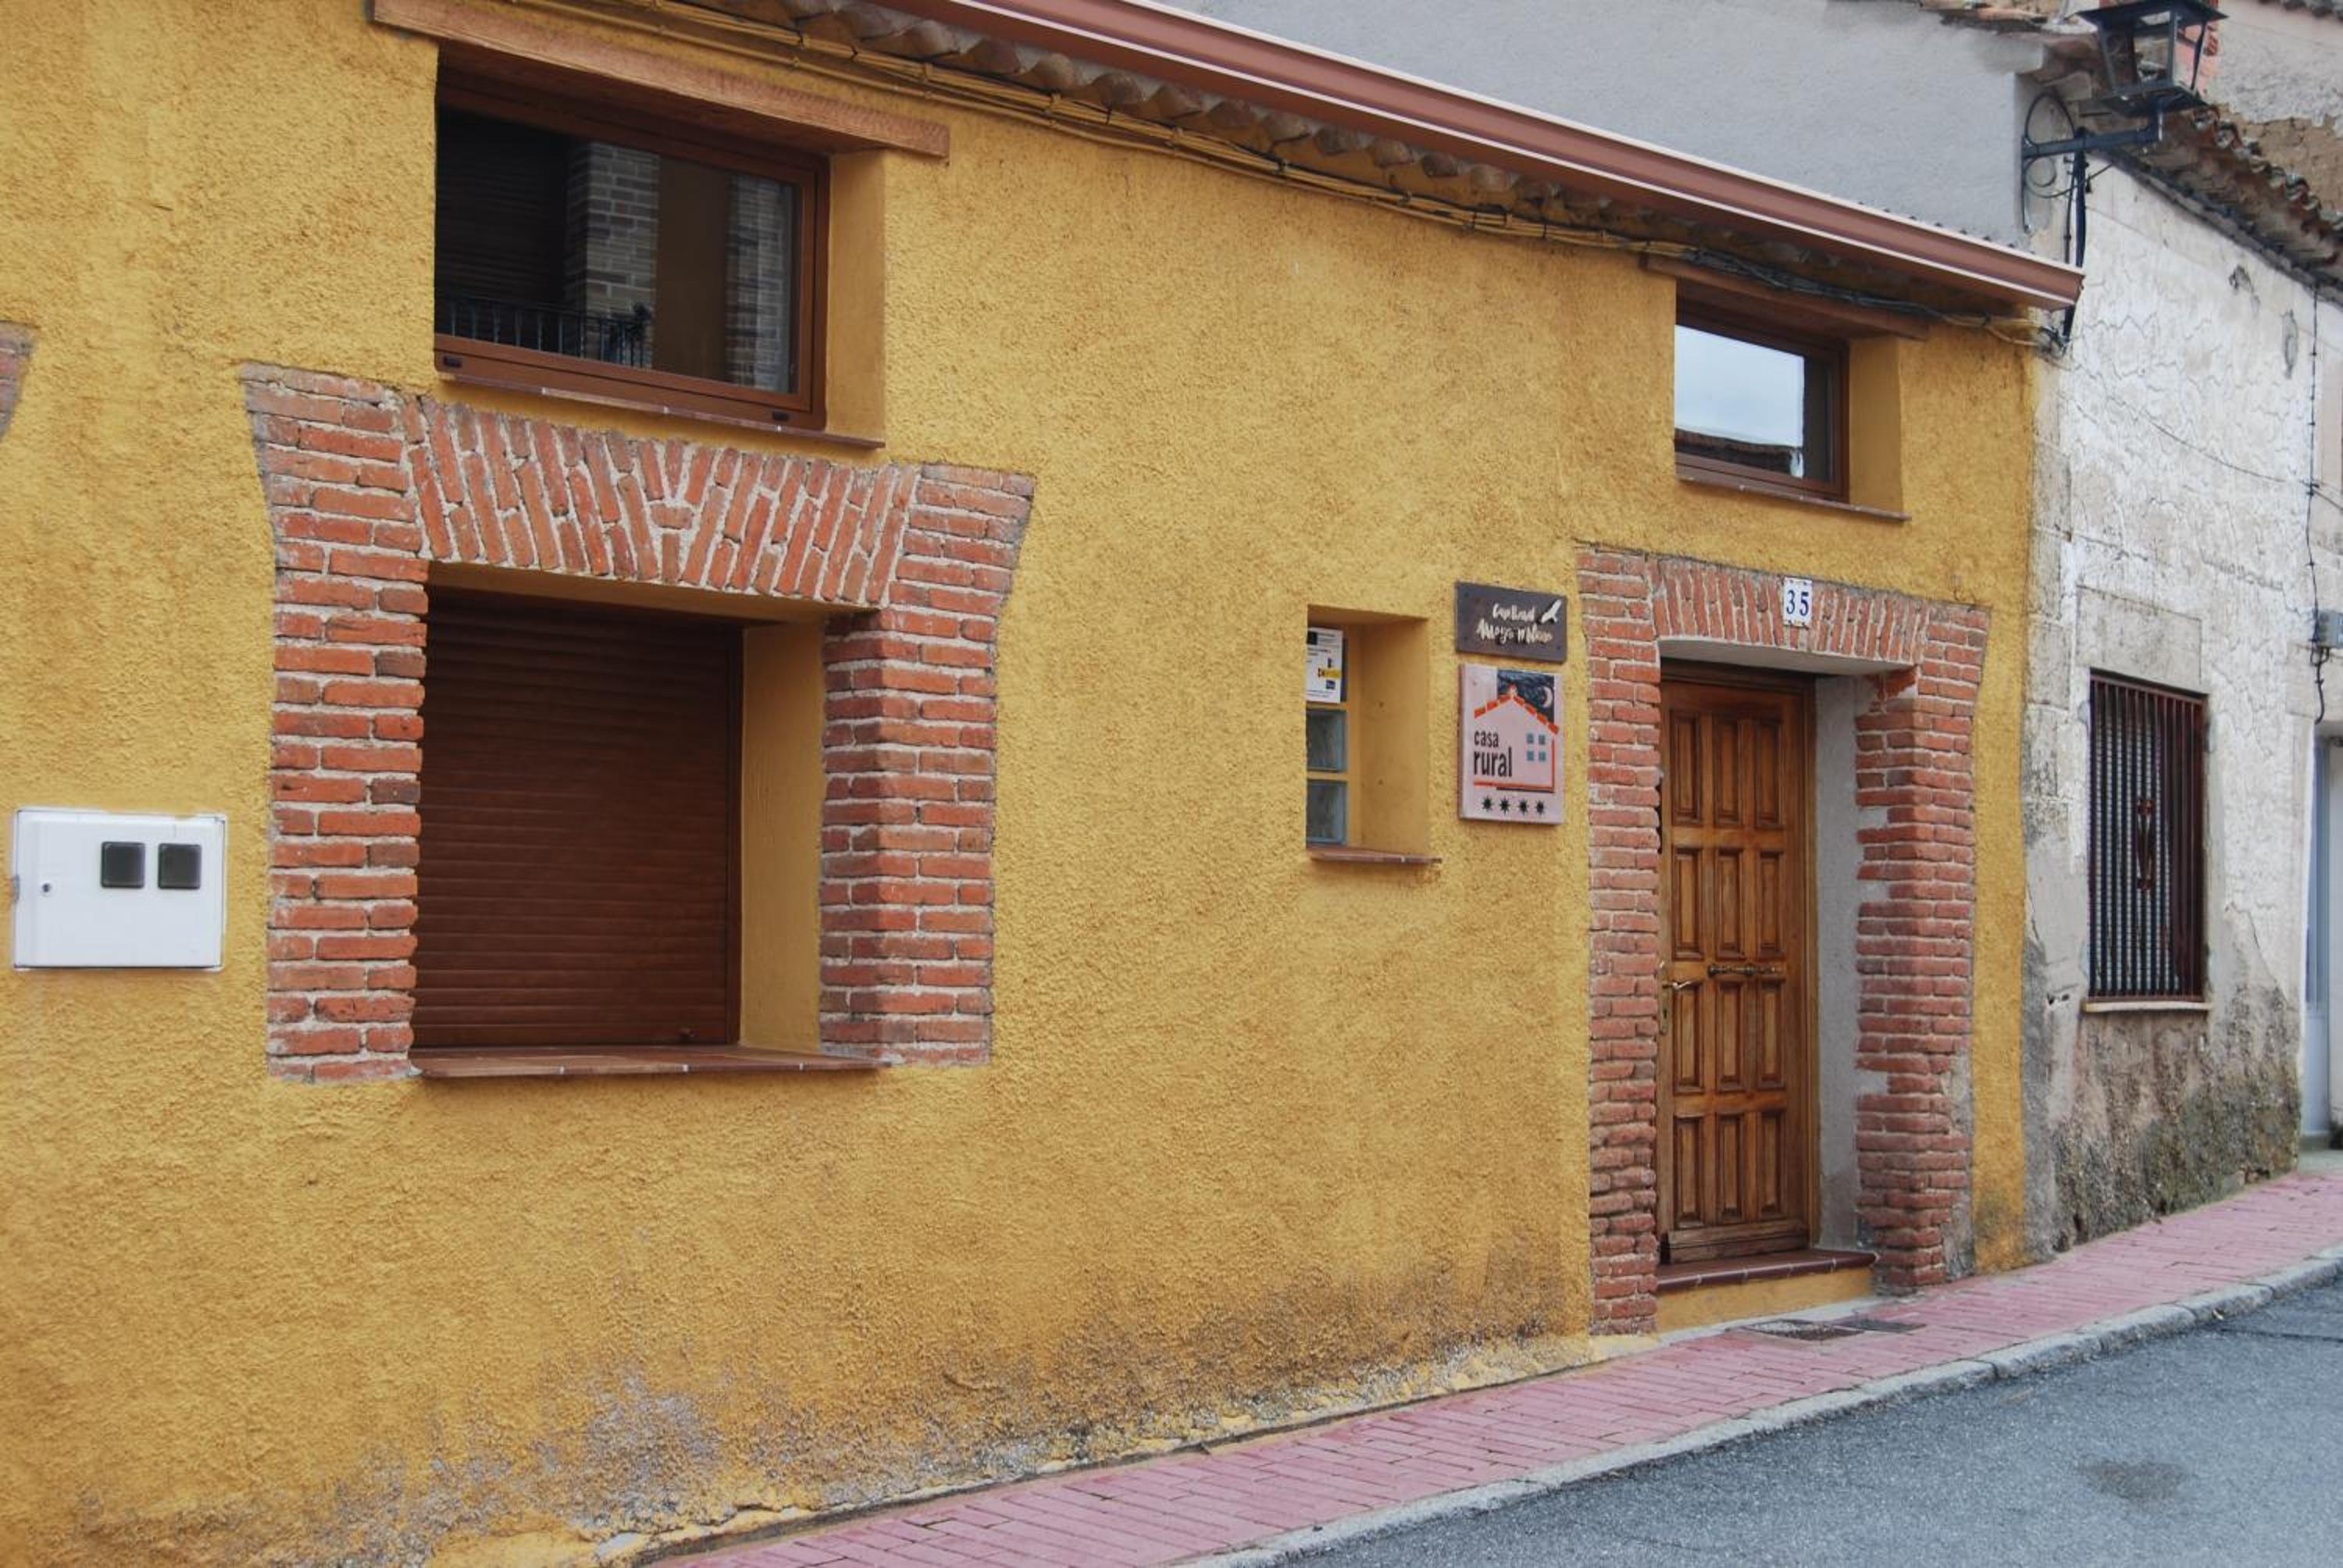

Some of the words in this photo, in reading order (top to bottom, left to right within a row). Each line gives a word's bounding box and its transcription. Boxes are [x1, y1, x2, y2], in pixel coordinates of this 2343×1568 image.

[1786, 590, 1809, 616] 35
[1474, 730, 1499, 747] casa
[1474, 747, 1512, 777] rural
